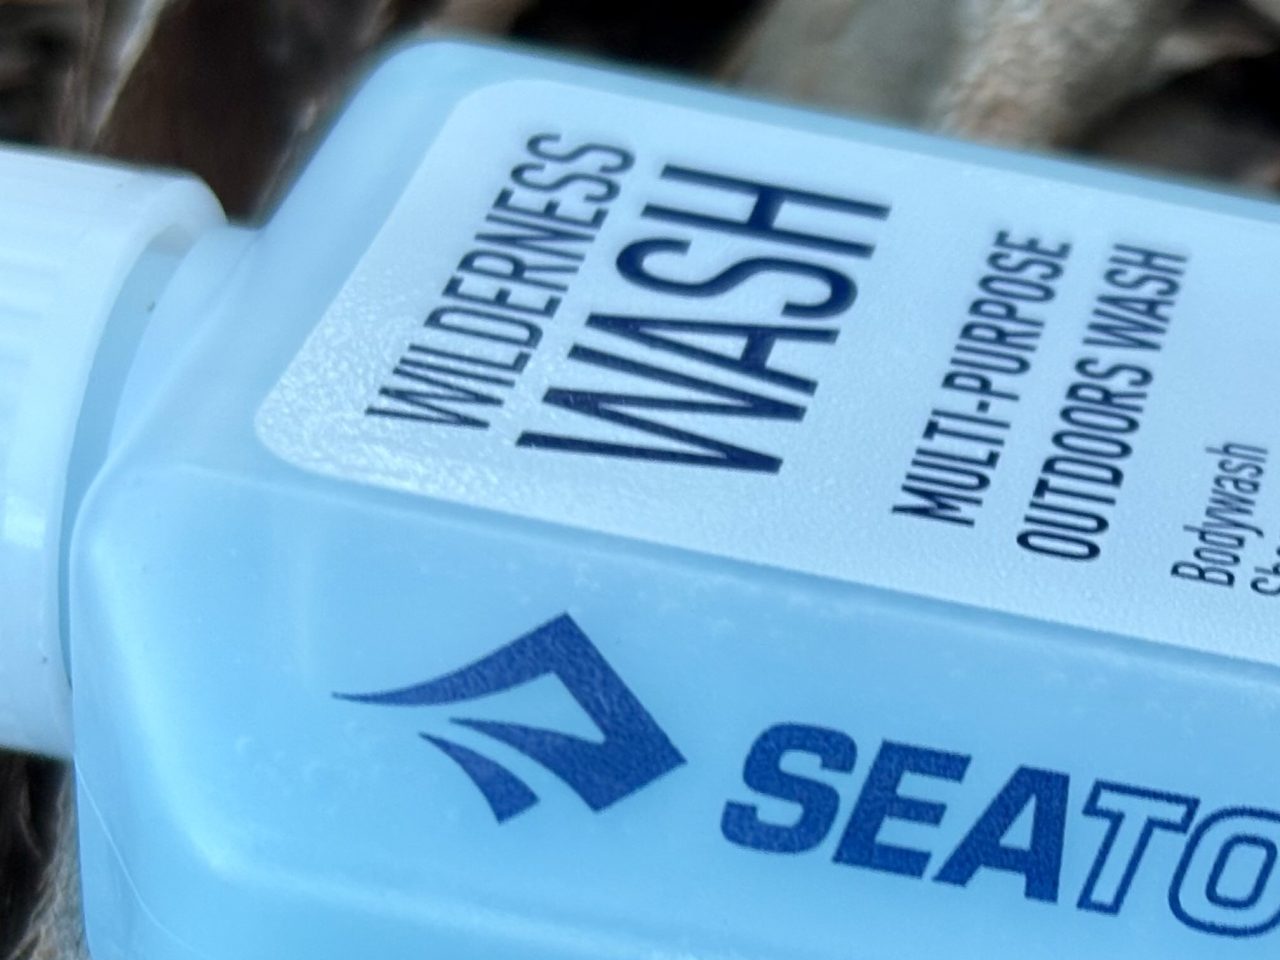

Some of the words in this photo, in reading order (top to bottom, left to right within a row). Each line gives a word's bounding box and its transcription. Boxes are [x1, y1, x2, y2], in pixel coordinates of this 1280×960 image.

[365, 132, 636, 431] WILDERNESS
[516, 163, 892, 475] WASH
[891, 230, 1073, 528] MULTI-PURPOSE
[1083, 243, 1191, 353] WASH
[1015, 356, 1153, 563] OUTDOORS
[1170, 442, 1269, 589] Bodywash
